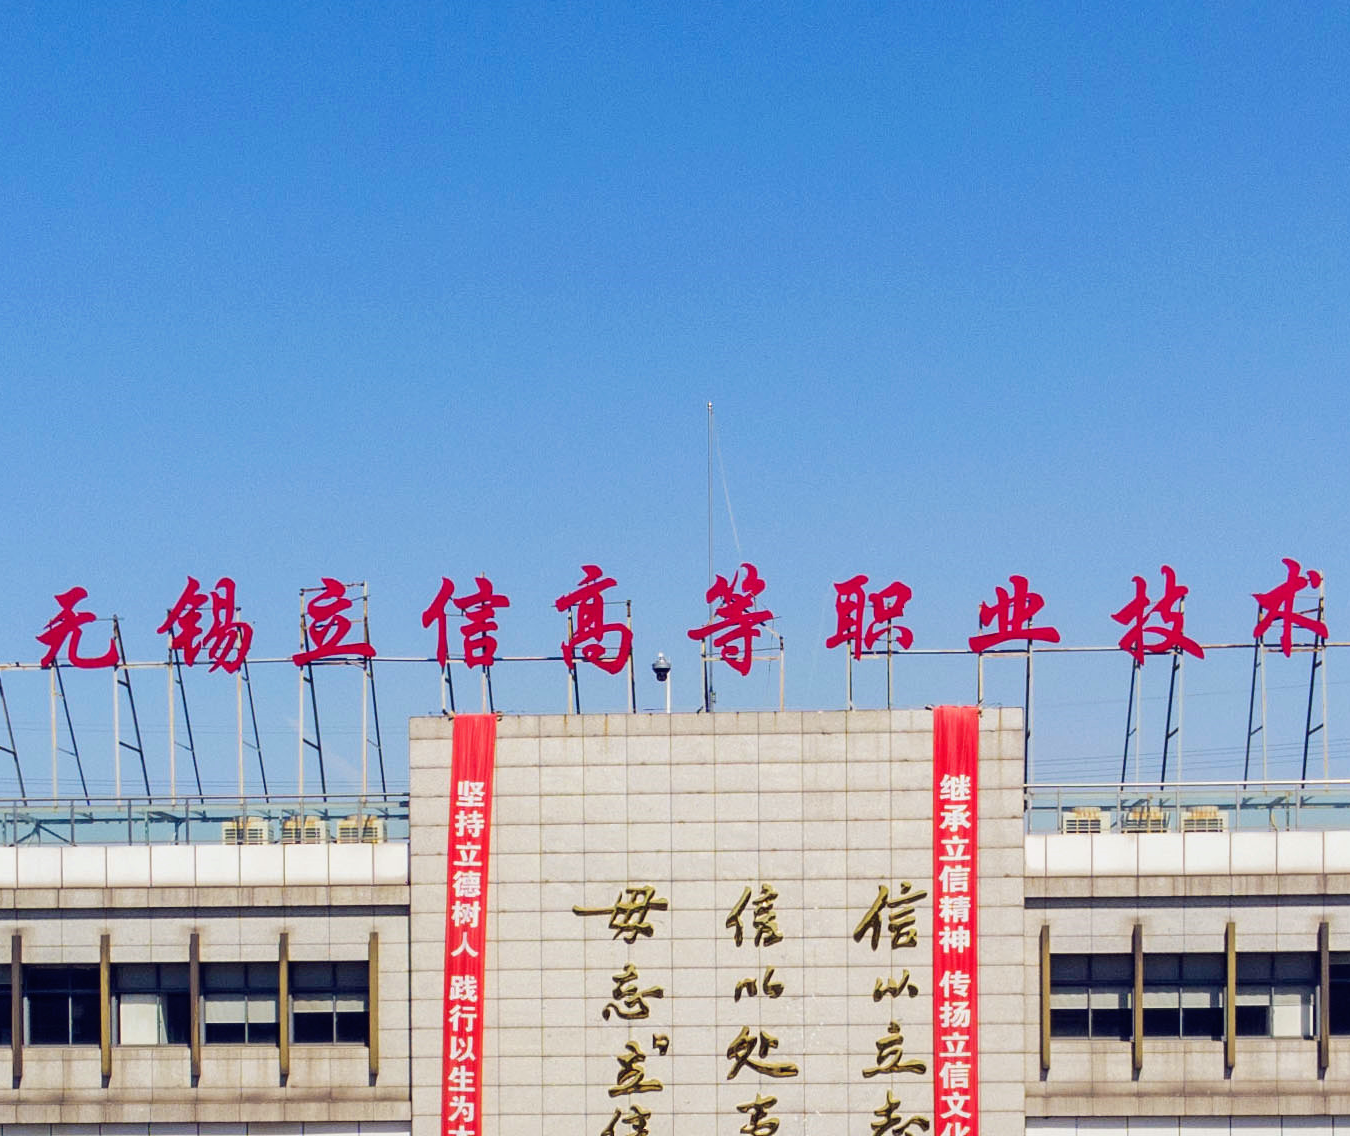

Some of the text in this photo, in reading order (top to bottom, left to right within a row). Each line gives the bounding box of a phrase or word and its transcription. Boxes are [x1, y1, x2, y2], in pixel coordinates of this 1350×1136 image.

[450, 780, 486, 958] 坚持立德树人
[938, 773, 972, 954] 继承立信精神
